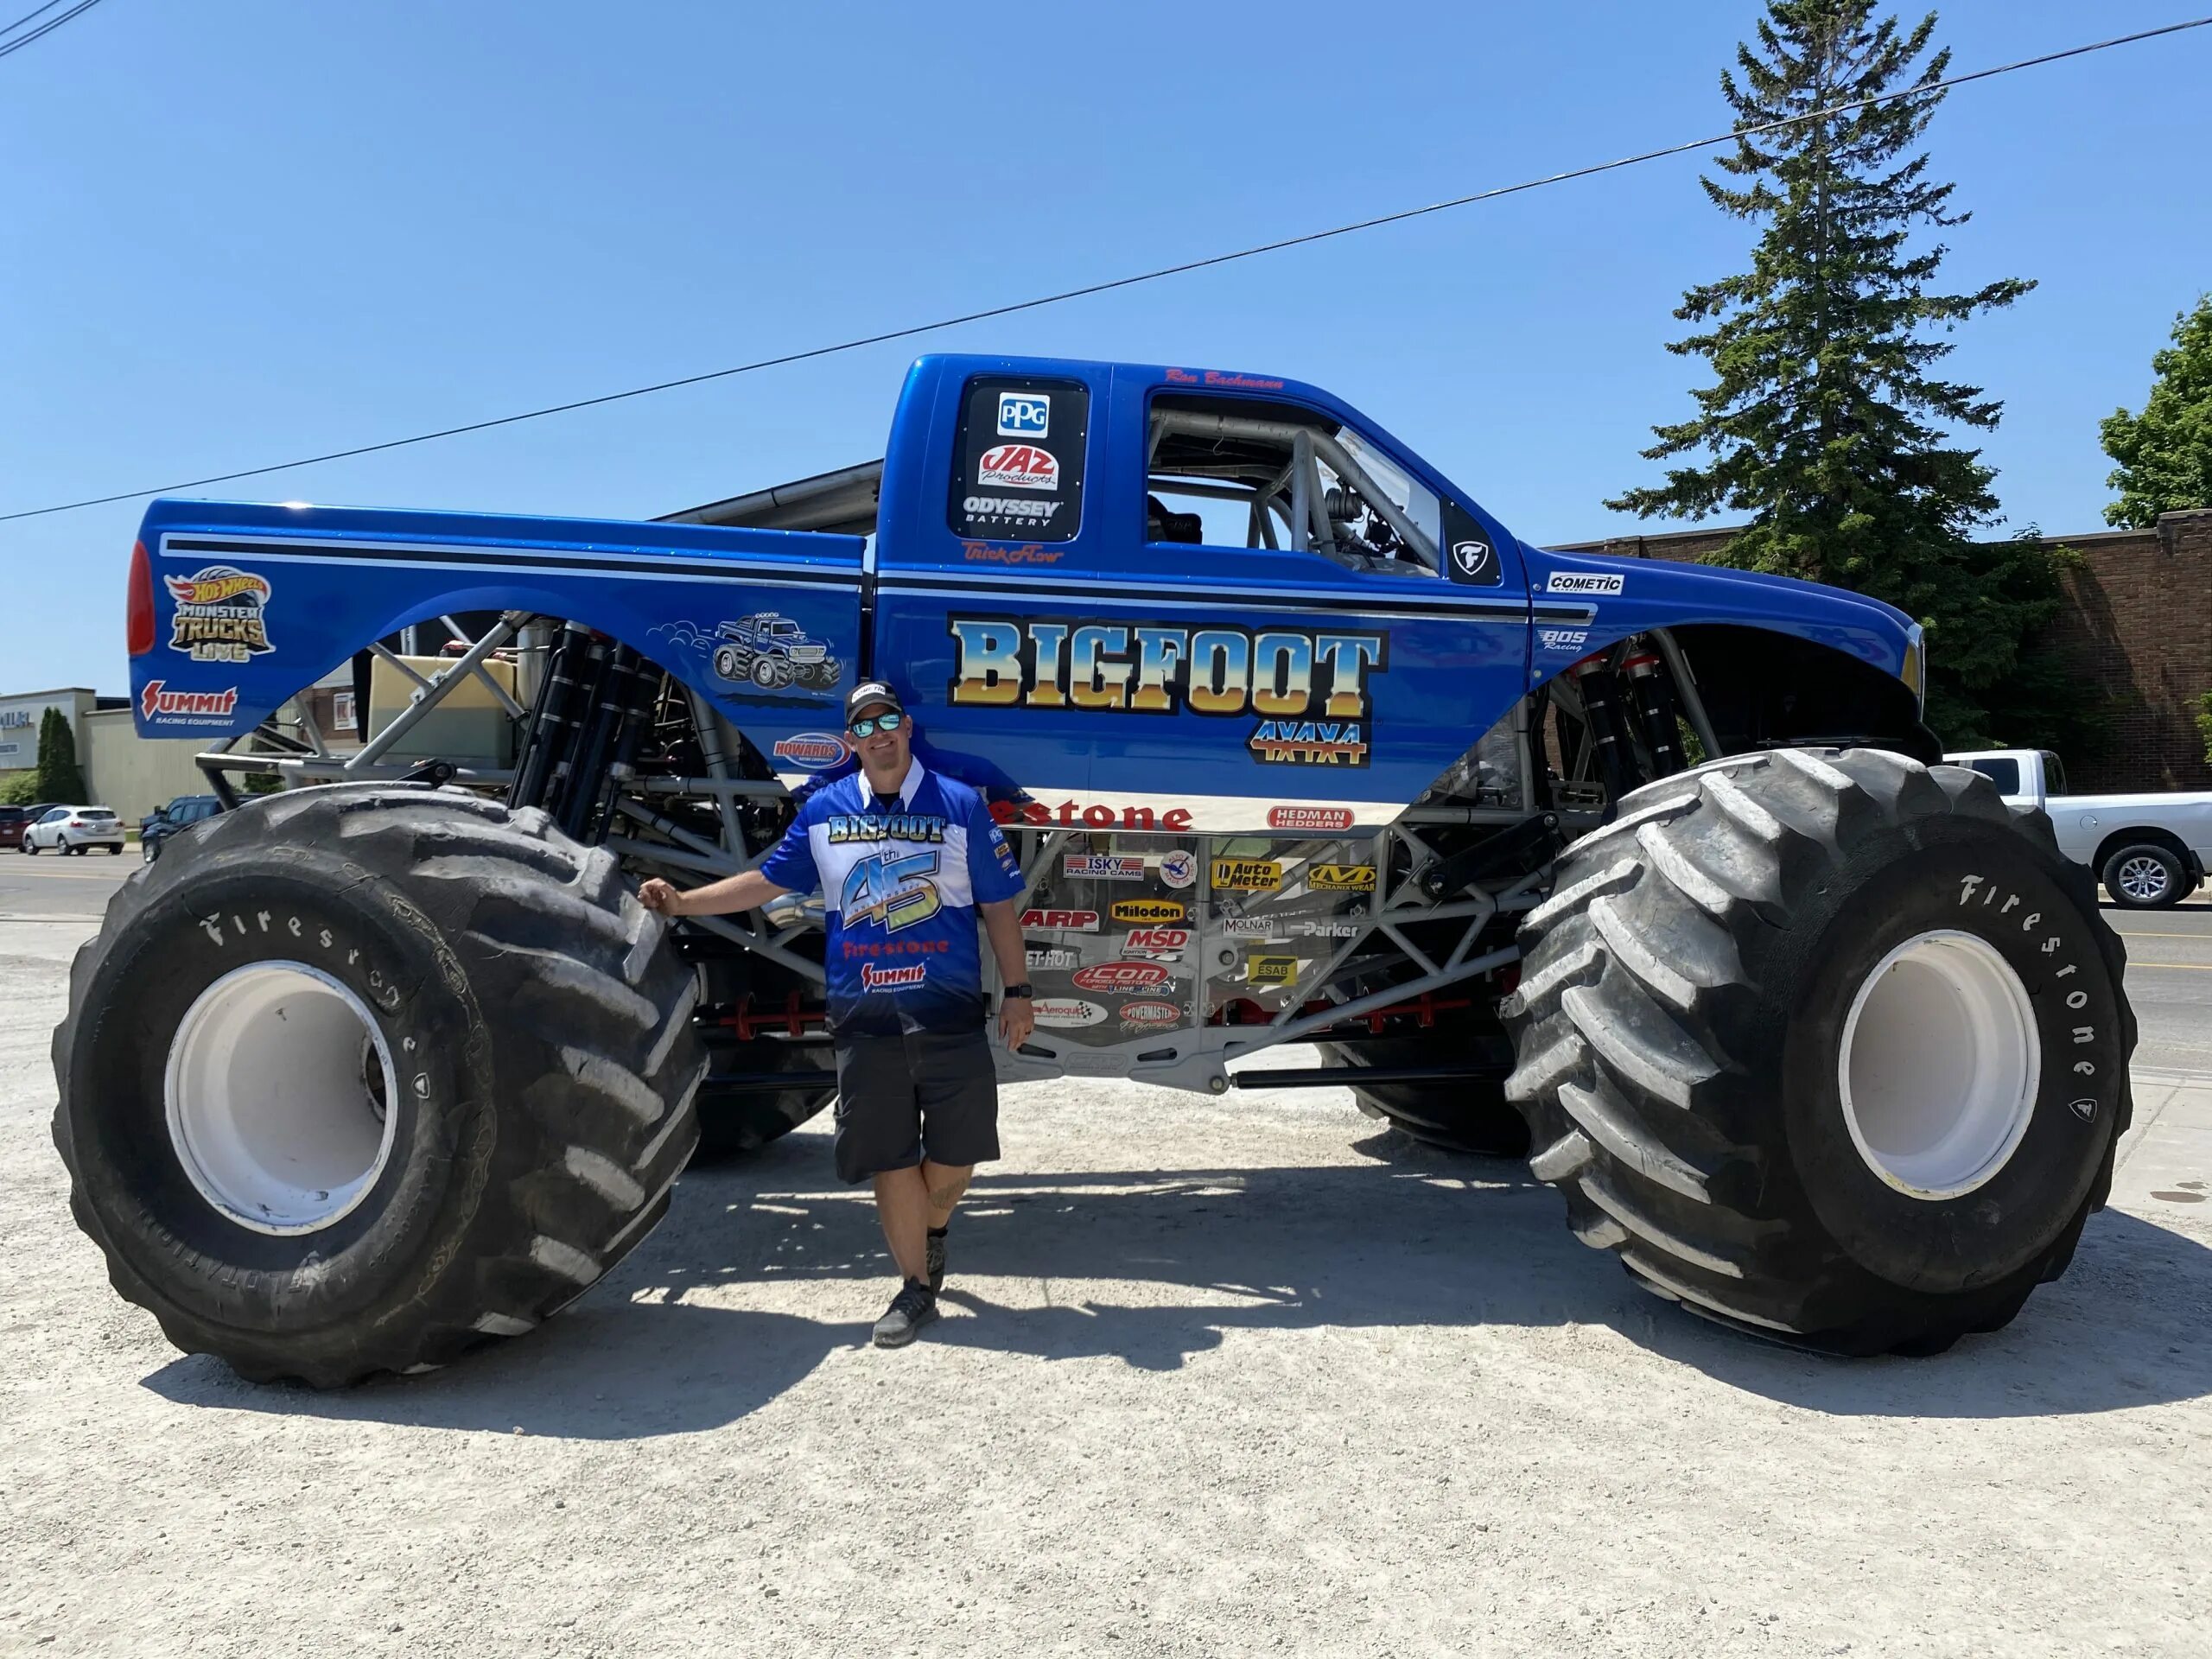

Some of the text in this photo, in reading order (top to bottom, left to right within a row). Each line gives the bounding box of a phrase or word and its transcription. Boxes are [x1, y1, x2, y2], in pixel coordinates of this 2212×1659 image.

[1001, 401, 1046, 428] PPG
[982, 446, 1055, 474] JAZ
[982, 469, 1056, 485] Products
[963, 497, 1061, 518] ODYSSEY
[965, 515, 1051, 526] BATTERY
[1551, 576, 1621, 590] COMETIC
[178, 605, 258, 620] MONSTER
[175, 617, 264, 645] TRUCKS
[1540, 630, 1588, 644] BOS
[192, 642, 249, 661] LIVE
[1543, 642, 1583, 652] Racing
[950, 619, 1381, 719] BIGFOOT
[188, 718, 235, 727] EQUIPMENT
[774, 742, 837, 757] HOWARDS
[1249, 721, 1367, 765] 4X4X4
[988, 798, 1193, 831] estone
[1276, 809, 1345, 821] HEDMAN
[1275, 819, 1344, 829] HEDDERS
[1087, 858, 1123, 870] ISKY
[1233, 863, 1272, 875] Auto
[1230, 874, 1279, 887] Meter
[1309, 880, 1376, 892] MECHANIX WEAR
[841, 851, 942, 932] 45
[1020, 910, 1098, 927] ARP
[1115, 905, 1180, 918] Milodon
[1225, 918, 1271, 932] MOLNAR
[1303, 921, 1358, 938] Parker
[1126, 931, 1188, 947] MSD
[842, 939, 949, 961] Firestone
[1026, 950, 1075, 968] ET-HOT
[1257, 965, 1288, 976] ESAB
[1959, 874, 2095, 1077] Firestone
[1127, 1005, 1173, 1020] POWERMASTER
